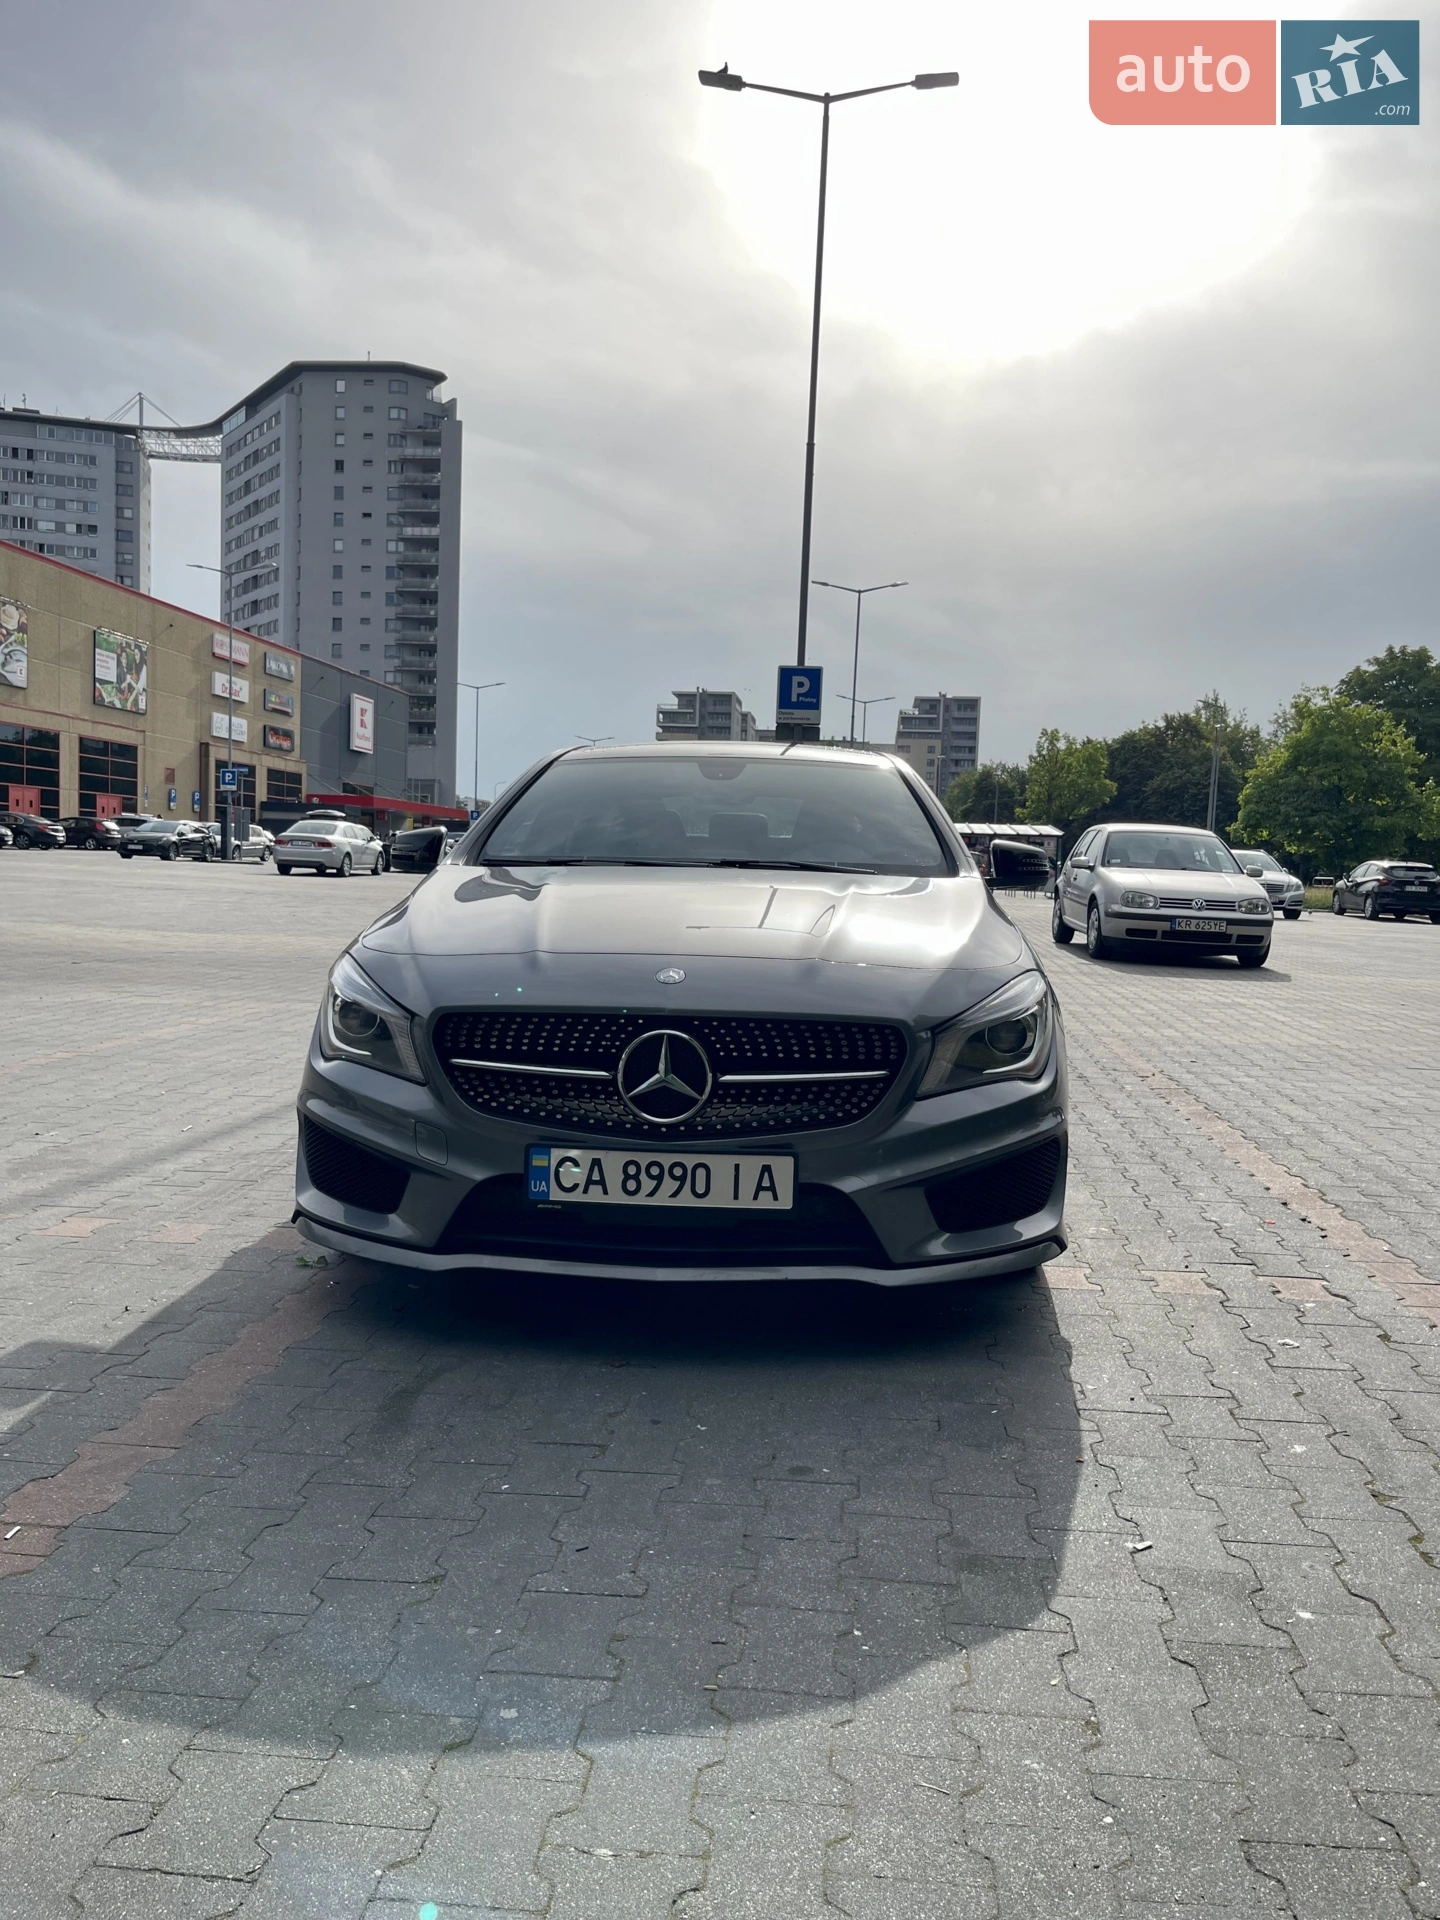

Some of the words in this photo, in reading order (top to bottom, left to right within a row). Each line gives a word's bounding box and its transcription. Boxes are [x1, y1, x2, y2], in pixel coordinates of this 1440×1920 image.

[791, 675, 811, 703] P
[1177, 920, 1192, 930] KR
[531, 1180, 548, 1193] UA
[554, 1155, 609, 1196] CA
[621, 1159, 712, 1200] 8990
[733, 1163, 779, 1202] IA
